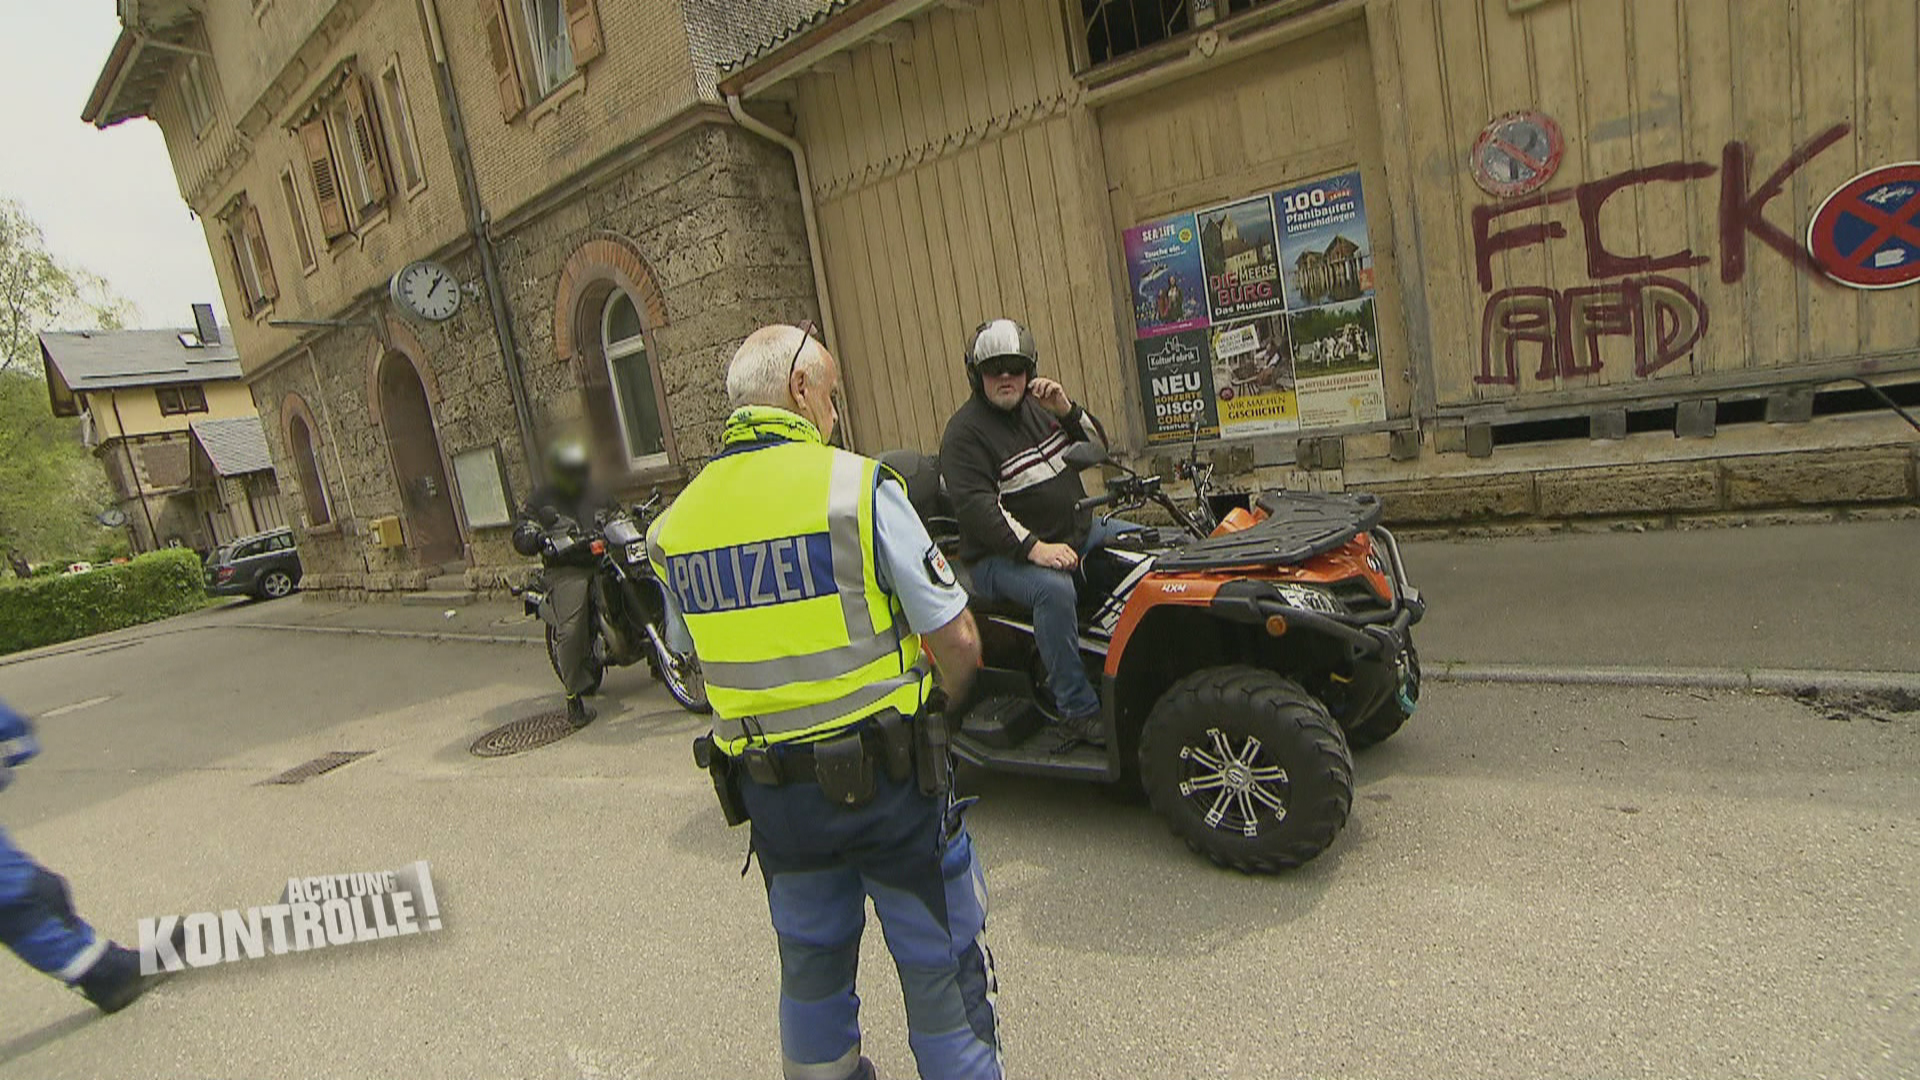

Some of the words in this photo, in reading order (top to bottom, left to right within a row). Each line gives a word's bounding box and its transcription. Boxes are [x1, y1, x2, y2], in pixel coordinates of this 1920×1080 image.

[1283, 188, 1326, 214] 100
[1286, 201, 1355, 224] Pfahlbauten
[1472, 122, 1850, 290] FCK
[1287, 211, 1356, 233] Unteruhldingen
[1210, 271, 1239, 290] DIE
[1239, 263, 1277, 284] MEERS
[1218, 281, 1272, 307] BURG
[1215, 306, 1234, 317] Das
[1236, 297, 1281, 312] Museum
[1152, 371, 1201, 397] NEU
[1155, 391, 1202, 404] KONZERTE
[1155, 399, 1205, 417] DISCO
[1228, 405, 1286, 420] GESCHICHTE
[673, 536, 816, 612] POLIZEI
